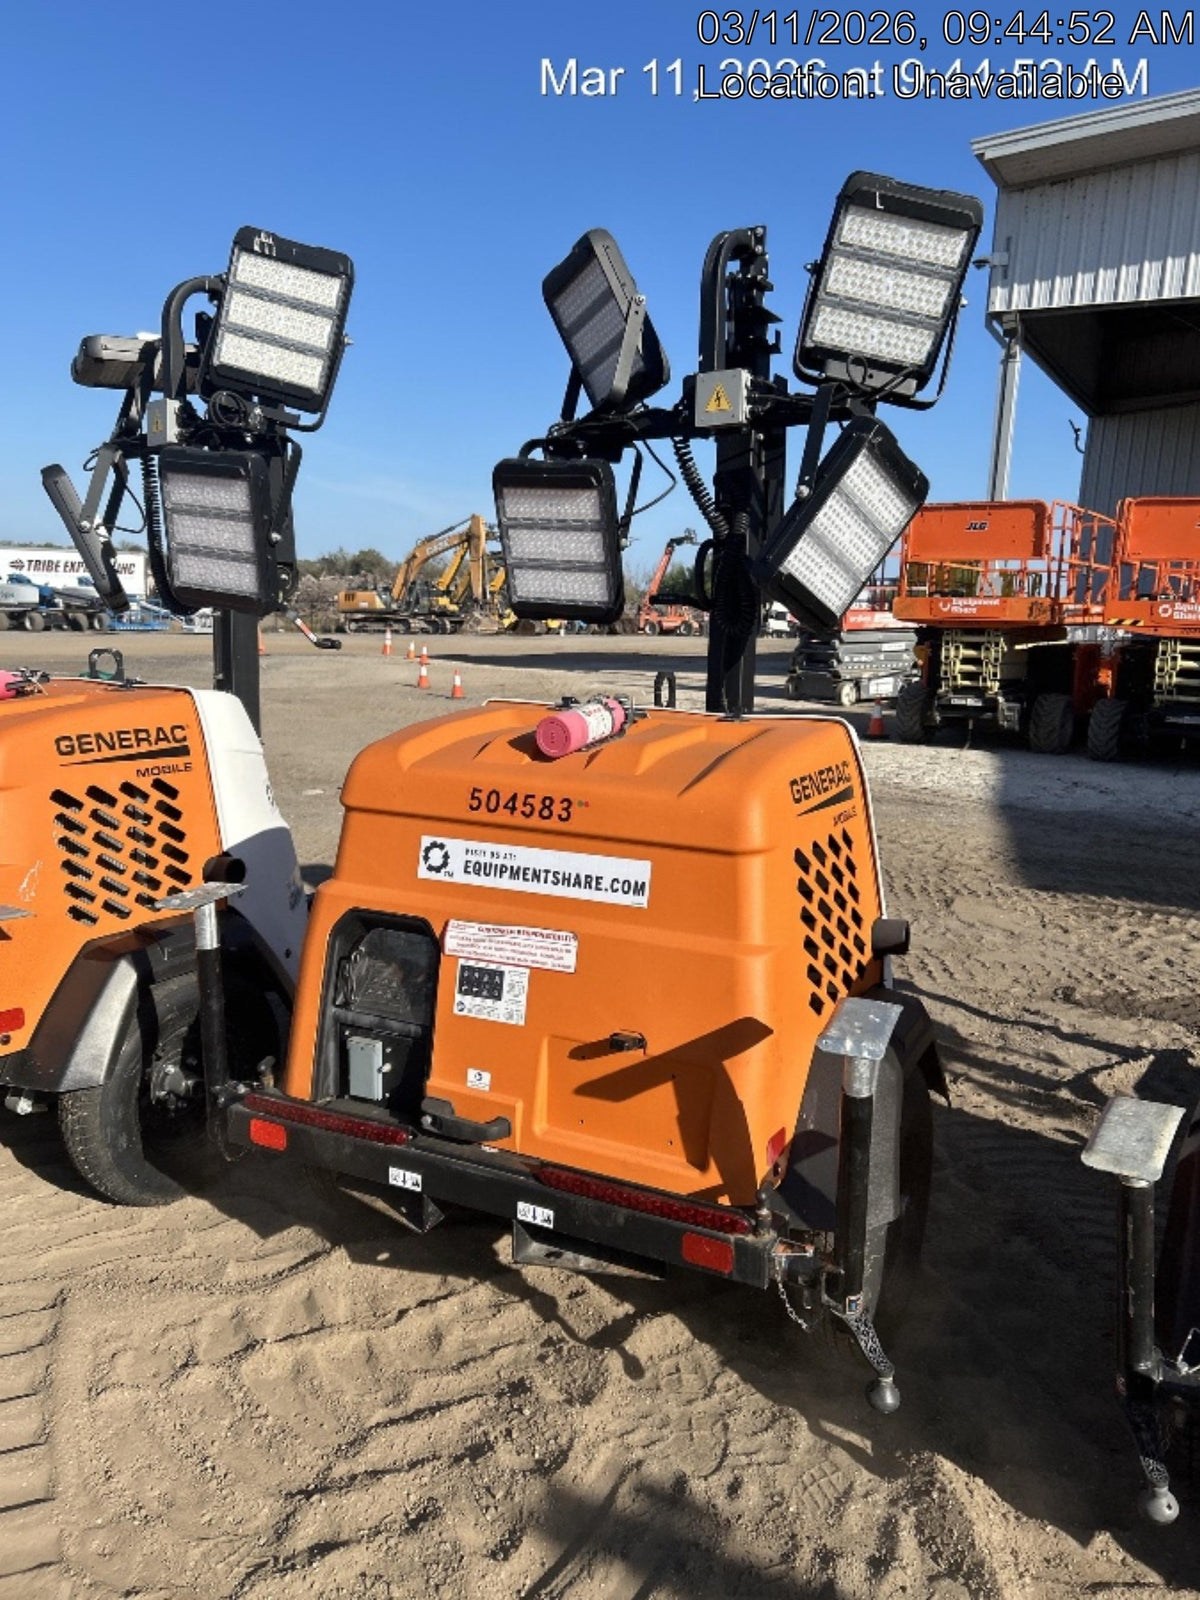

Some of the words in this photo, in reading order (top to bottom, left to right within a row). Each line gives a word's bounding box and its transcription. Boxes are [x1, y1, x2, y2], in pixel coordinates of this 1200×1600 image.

[966, 521, 989, 531] JLG
[27, 560, 61, 572] TRIBE
[54, 724, 188, 757] GENERAC
[136, 762, 193, 778] MOBILE
[789, 760, 851, 804] GENERAC
[468, 787, 573, 823] 504583
[463, 859, 647, 897] EQUIPMENTSHARE.COM
